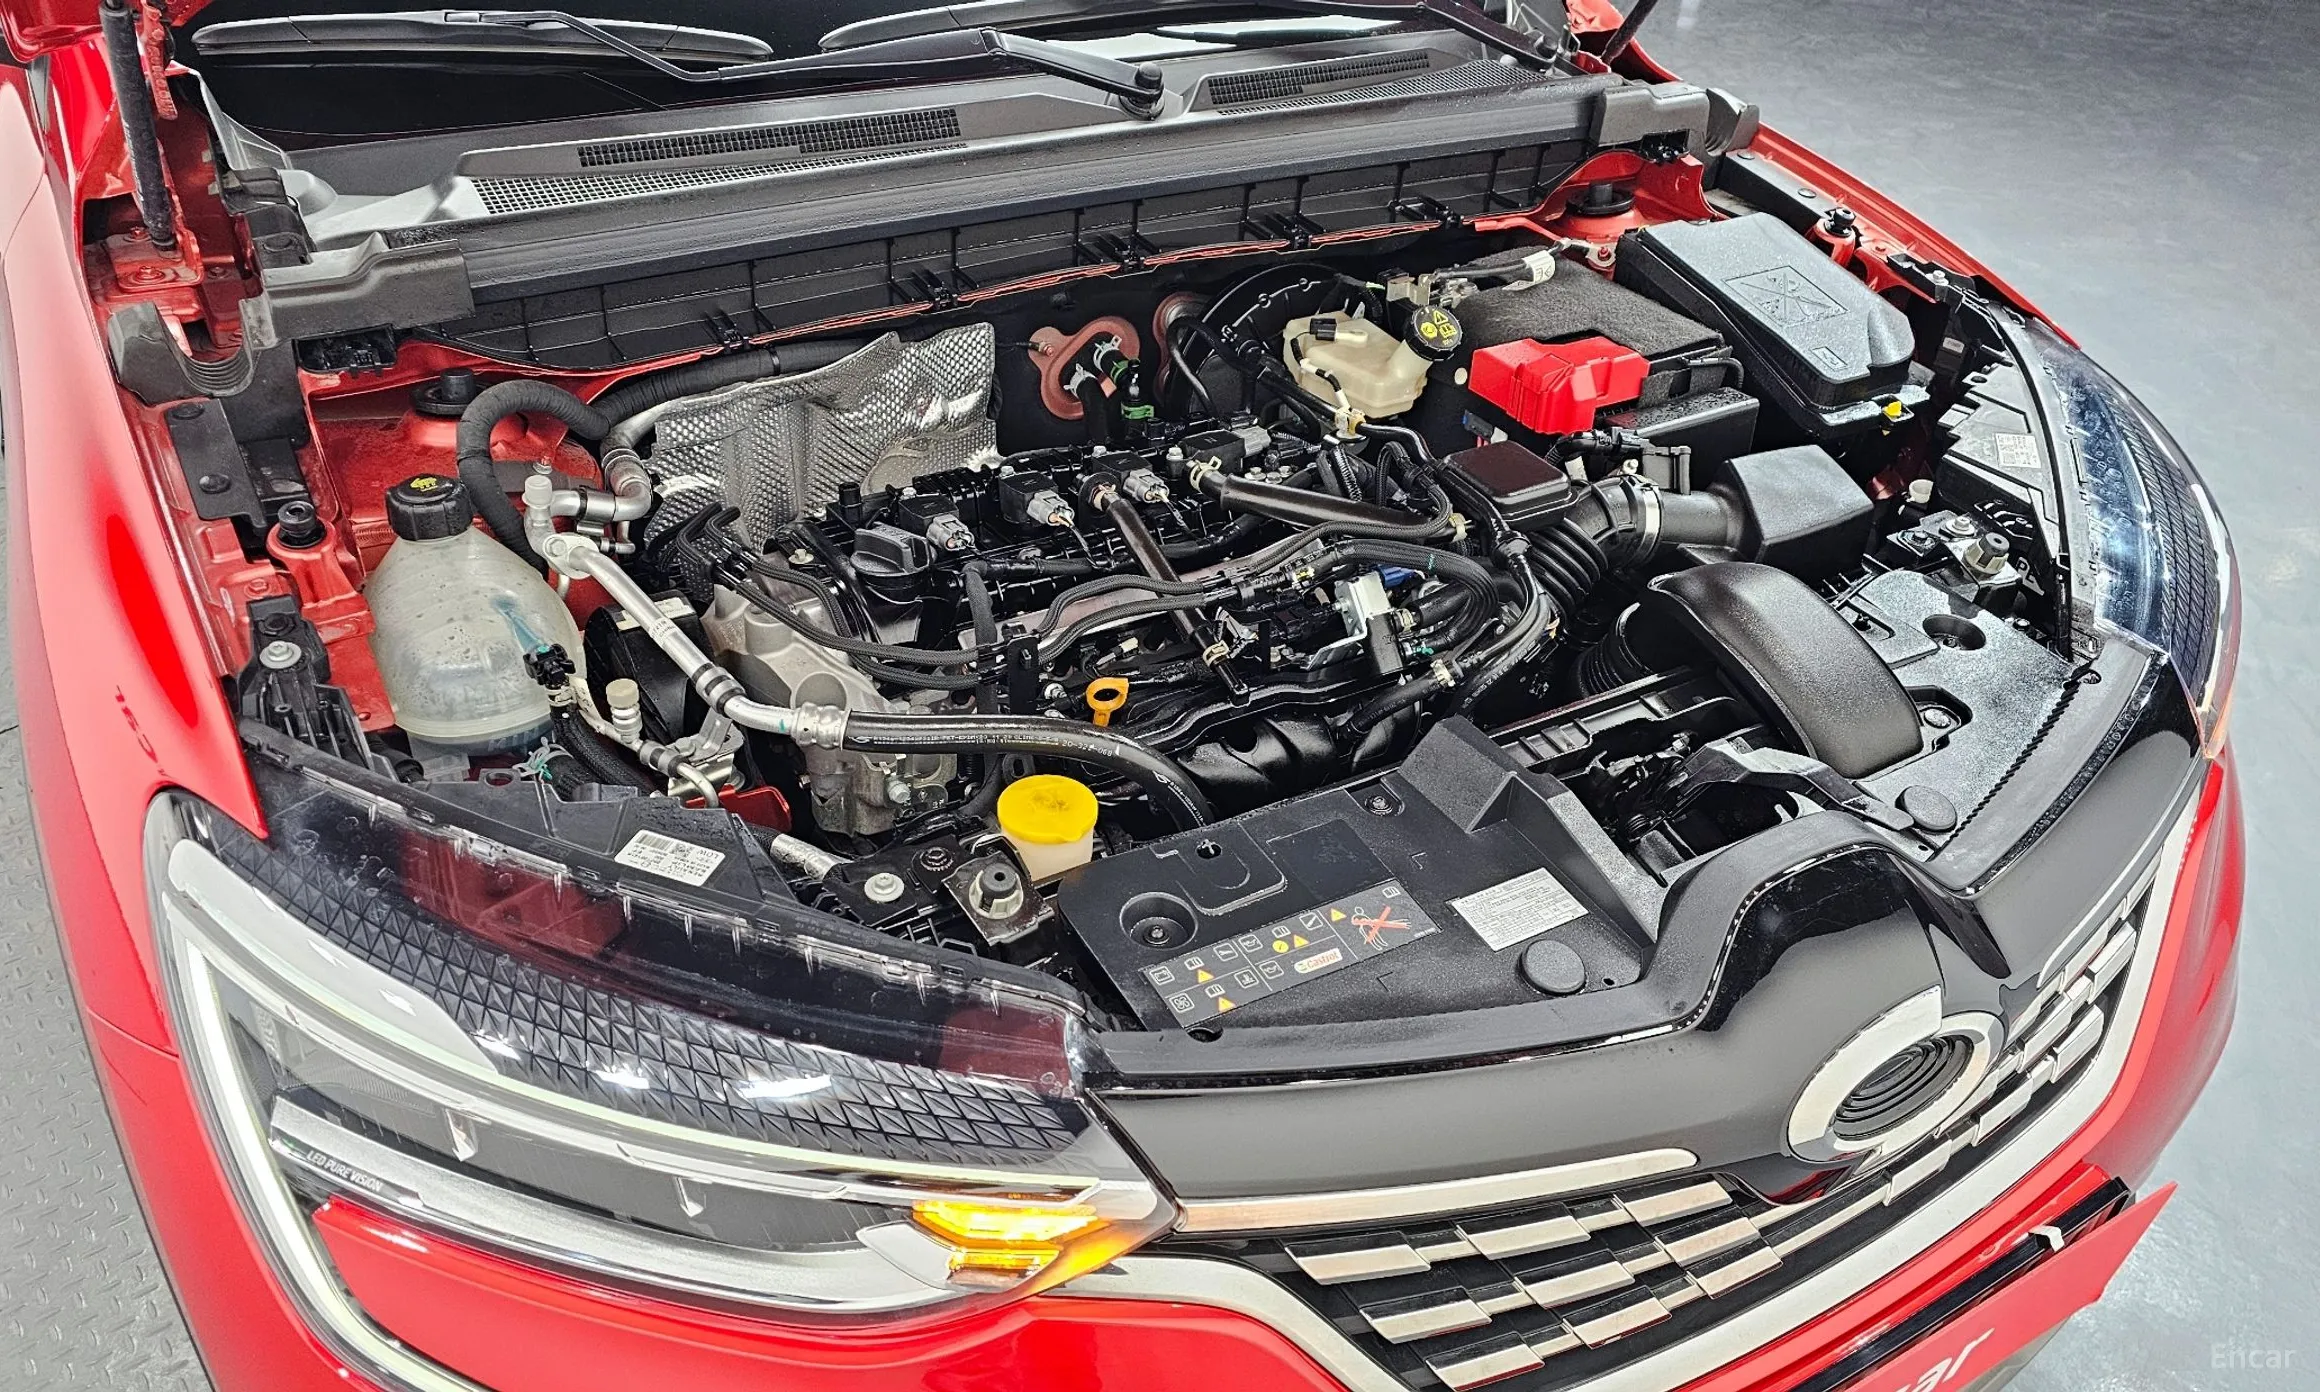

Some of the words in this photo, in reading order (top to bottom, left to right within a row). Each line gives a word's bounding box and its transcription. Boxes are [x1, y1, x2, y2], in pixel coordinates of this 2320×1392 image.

[1307, 951, 1338, 969] Castrol
[306, 1150, 327, 1166] LED
[325, 1160, 351, 1179] PURE
[349, 1170, 384, 1193] VISION
[1895, 1327, 1996, 1392] ar
